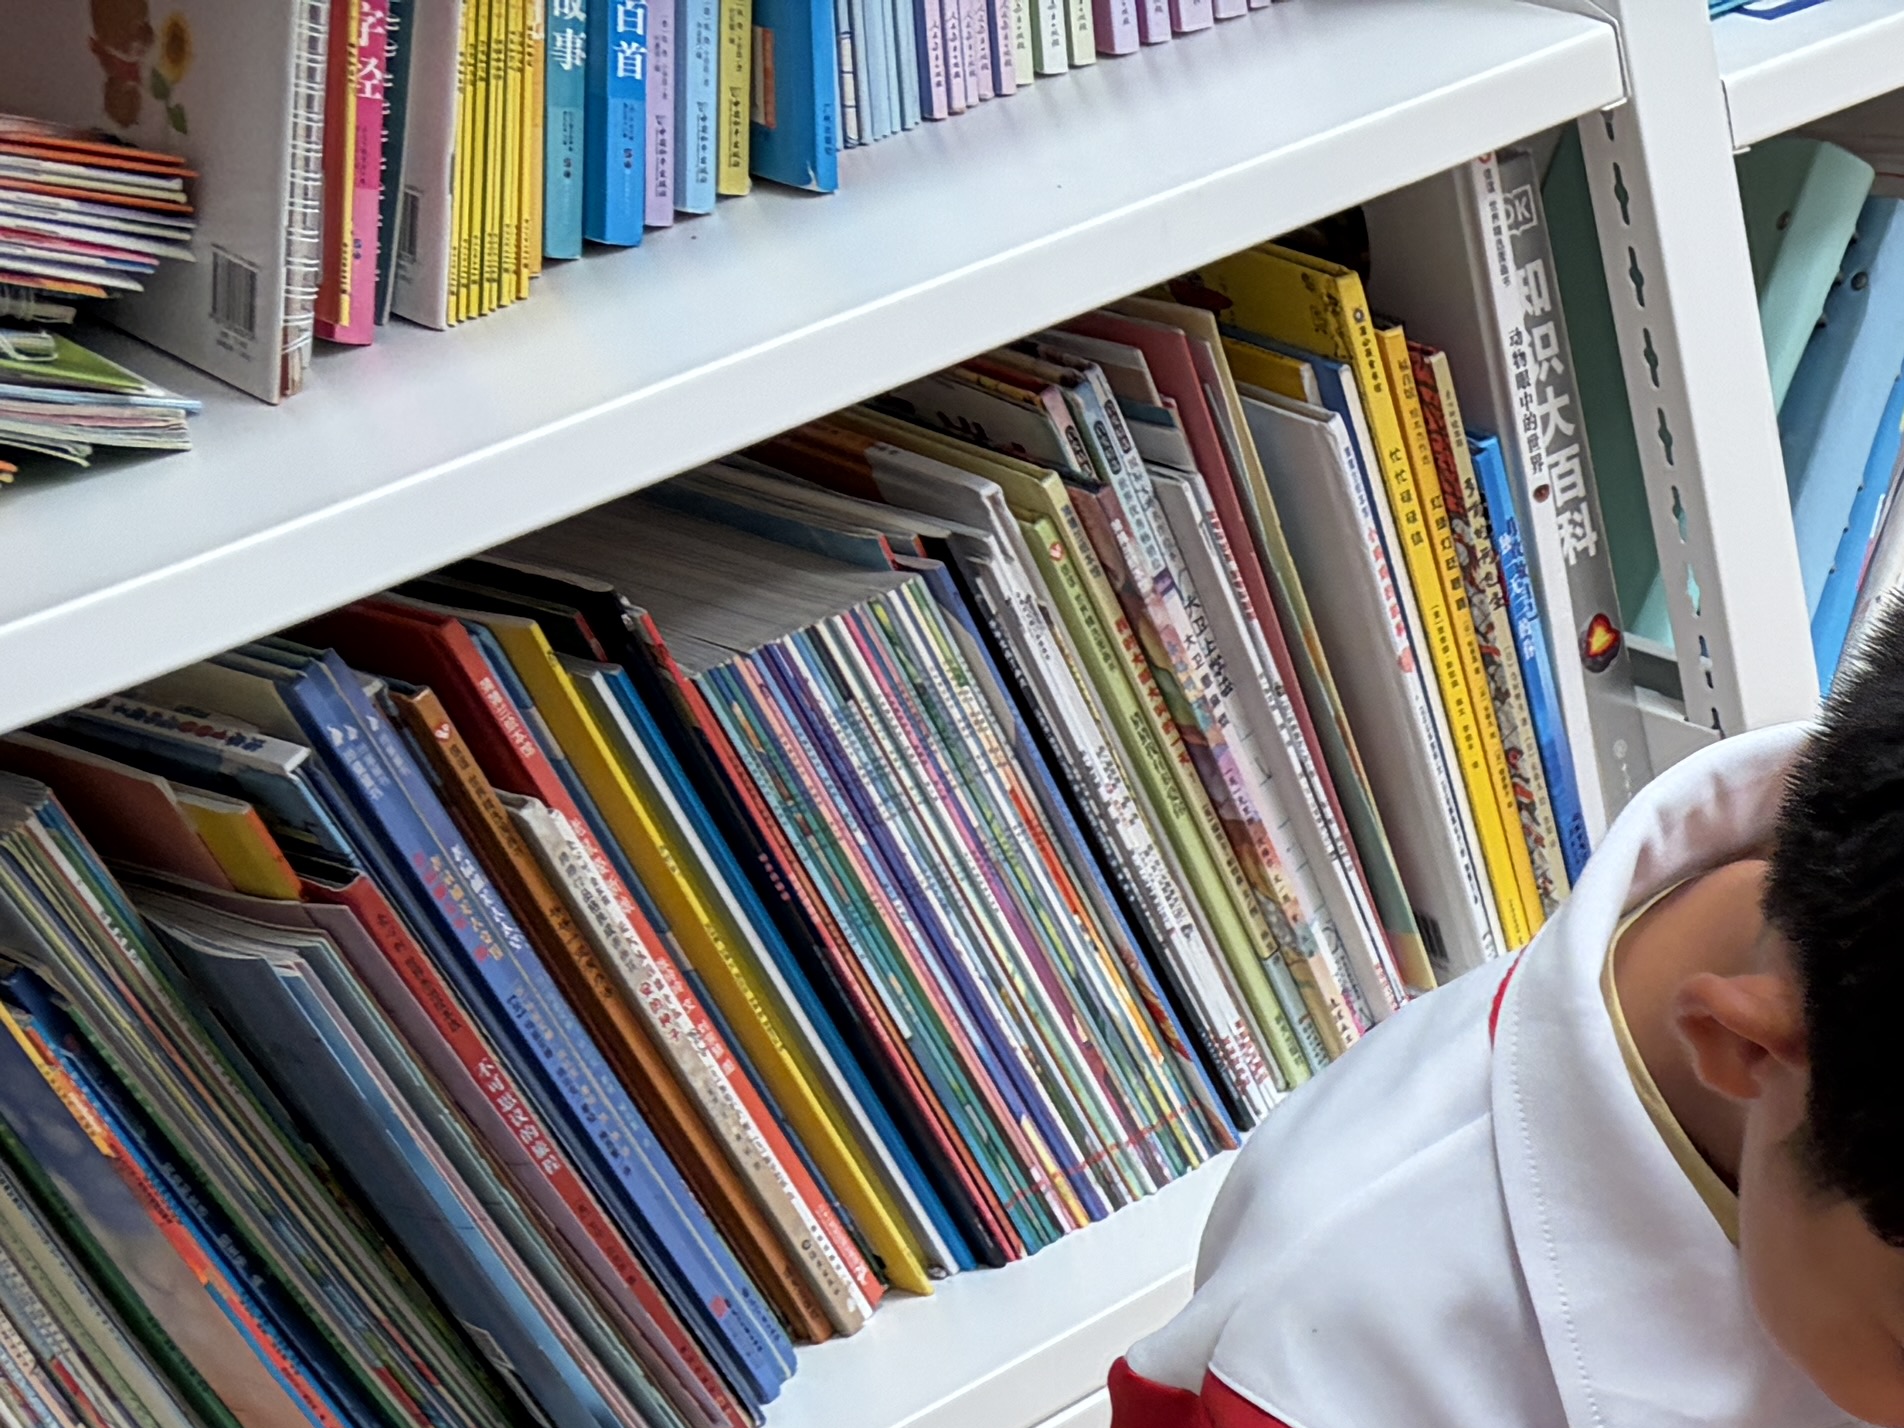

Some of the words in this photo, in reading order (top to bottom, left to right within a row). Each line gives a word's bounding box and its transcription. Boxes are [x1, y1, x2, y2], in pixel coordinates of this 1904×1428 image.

[612, 0, 648, 80] 百首
[1508, 326, 1544, 475] 动物眼中的世界
[1516, 258, 1599, 566] 知识大百科
[1388, 446, 1424, 546] 忙忙碌碌镇
